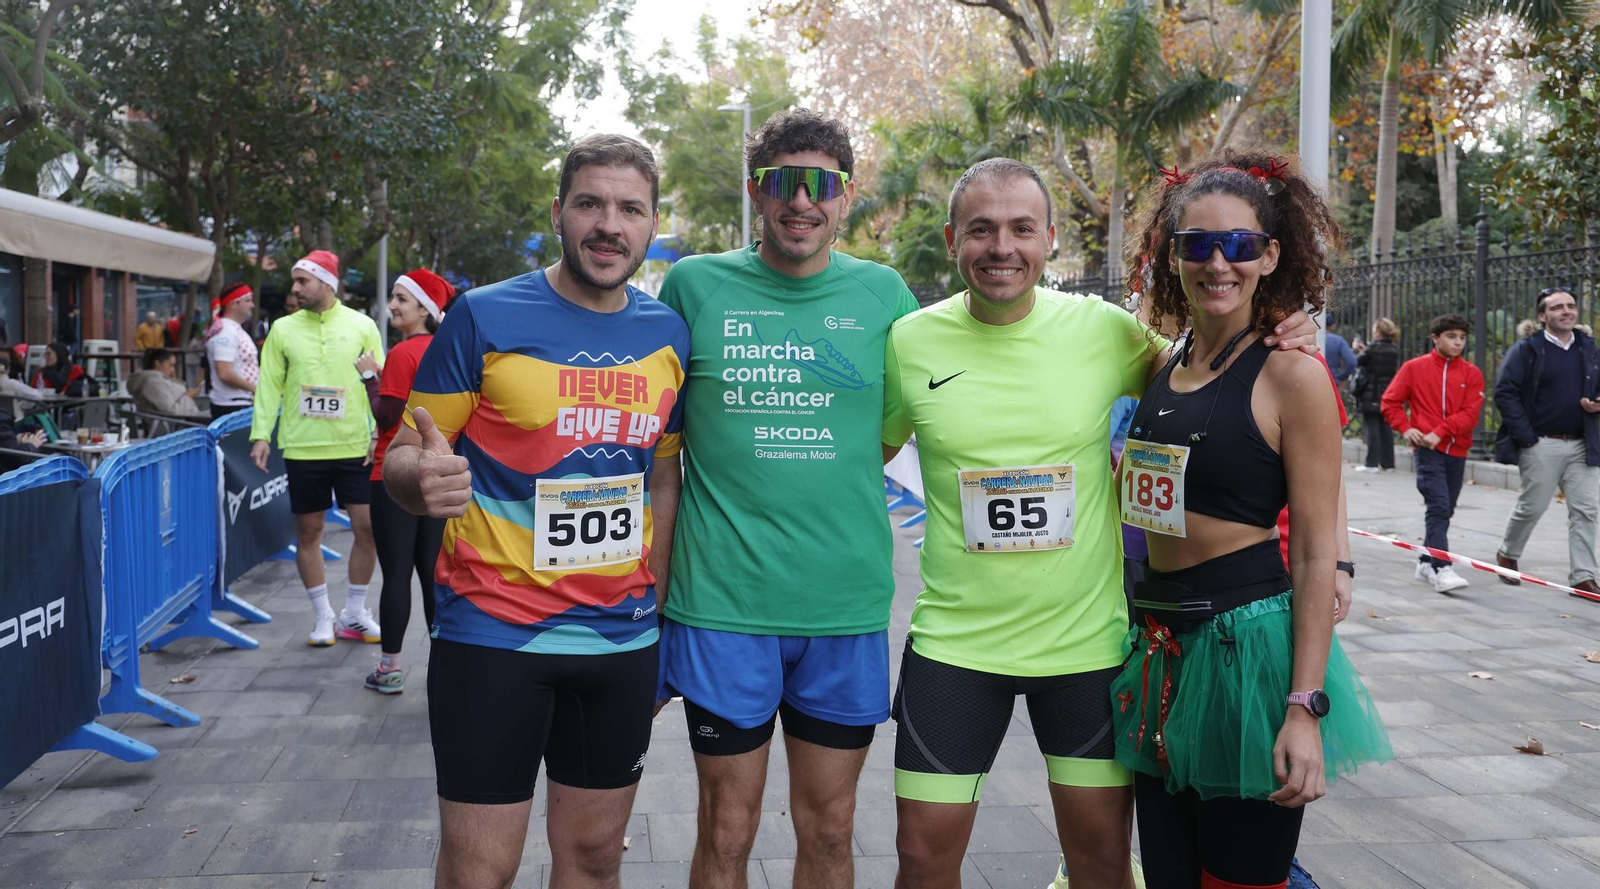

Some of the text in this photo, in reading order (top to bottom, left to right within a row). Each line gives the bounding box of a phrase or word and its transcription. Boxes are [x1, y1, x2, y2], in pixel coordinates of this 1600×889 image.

[758, 309, 785, 317] Algeciras
[723, 319, 753, 337] En
[722, 340, 816, 361] marcha
[722, 363, 802, 384] contra
[558, 369, 648, 405] NEVER
[722, 385, 835, 408] el cáncer
[304, 397, 340, 411] 119
[556, 407, 661, 445] GIVE UP
[755, 449, 837, 460] Grazalema Motor
[980, 476, 1017, 490] CARRERA
[1019, 473, 1054, 487] NAVIDAD
[1124, 469, 1174, 511] 183
[560, 489, 597, 504] CARRERA
[987, 496, 1048, 531] 65
[547, 507, 632, 547] 503
[991, 531, 1012, 539] CASTAÑO
[1034, 529, 1049, 537] JUSTO
